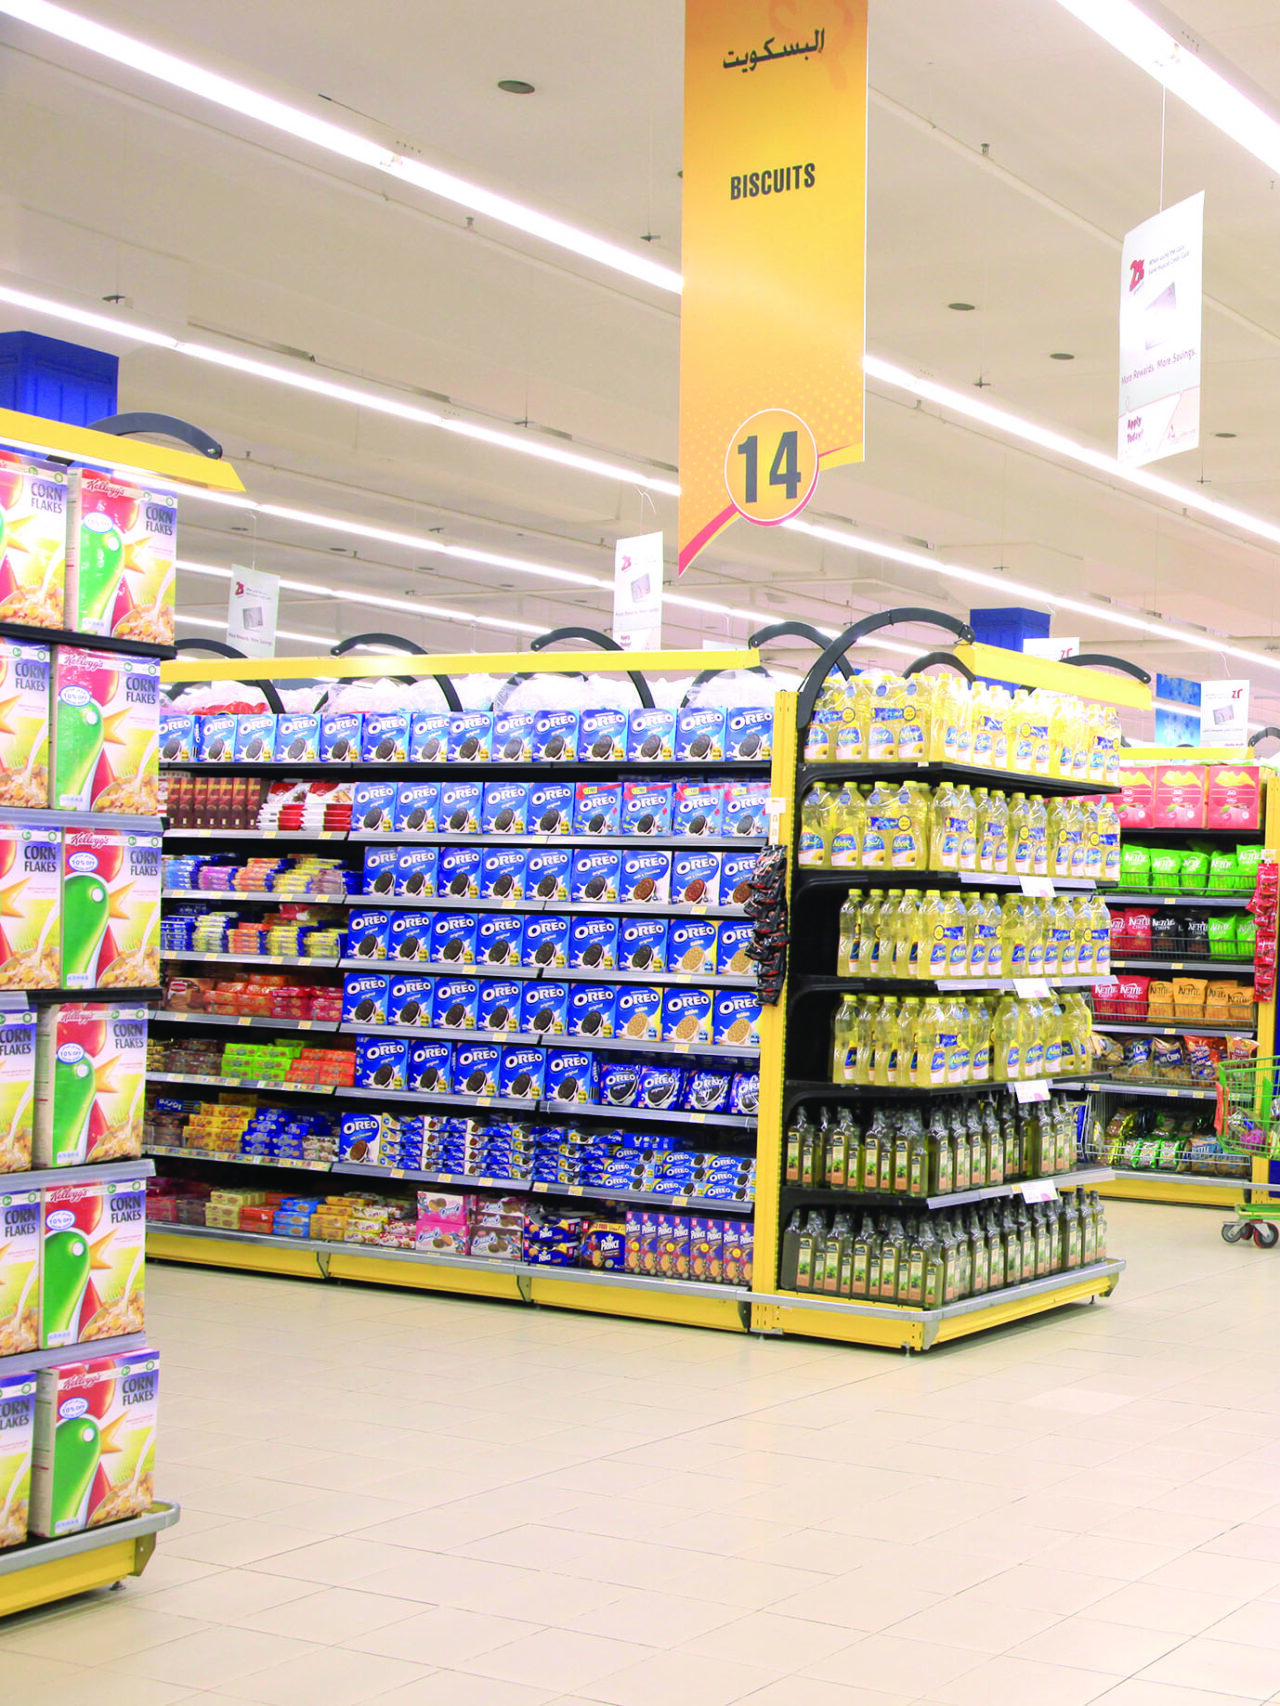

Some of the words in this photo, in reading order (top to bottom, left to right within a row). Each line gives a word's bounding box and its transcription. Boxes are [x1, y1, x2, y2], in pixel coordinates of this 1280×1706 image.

[723, 28, 825, 73] البسكويت
[731, 162, 815, 200] BISCUITS
[1128, 416, 1141, 430] Apply
[737, 431, 802, 503] 14
[86, 478, 125, 497] Kellogg's
[145, 506, 173, 524] CORN
[146, 519, 173, 536] FLAKES
[63, 655, 104, 670] Kellogg's
[125, 676, 156, 693] CORN
[126, 689, 156, 705] FLAKES
[238, 718, 274, 736] OREO
[324, 718, 359, 736] OREO
[487, 787, 526, 805] OREO
[71, 833, 109, 848] Kellogg's
[130, 851, 158, 865] CORN
[130, 862, 158, 876] FLAKES
[435, 917, 475, 935] OREO
[673, 926, 715, 944] OREO
[667, 995, 709, 1013] OREO
[606, 1073, 636, 1086] OREO
[666, 1154, 689, 1162] OREO
[50, 1188, 88, 1202] Kellogg's
[109, 1194, 142, 1212] CORN
[111, 1208, 142, 1224] FLAKES
[121, 1377, 154, 1395] CORN
[122, 1391, 154, 1406] FLAKES
